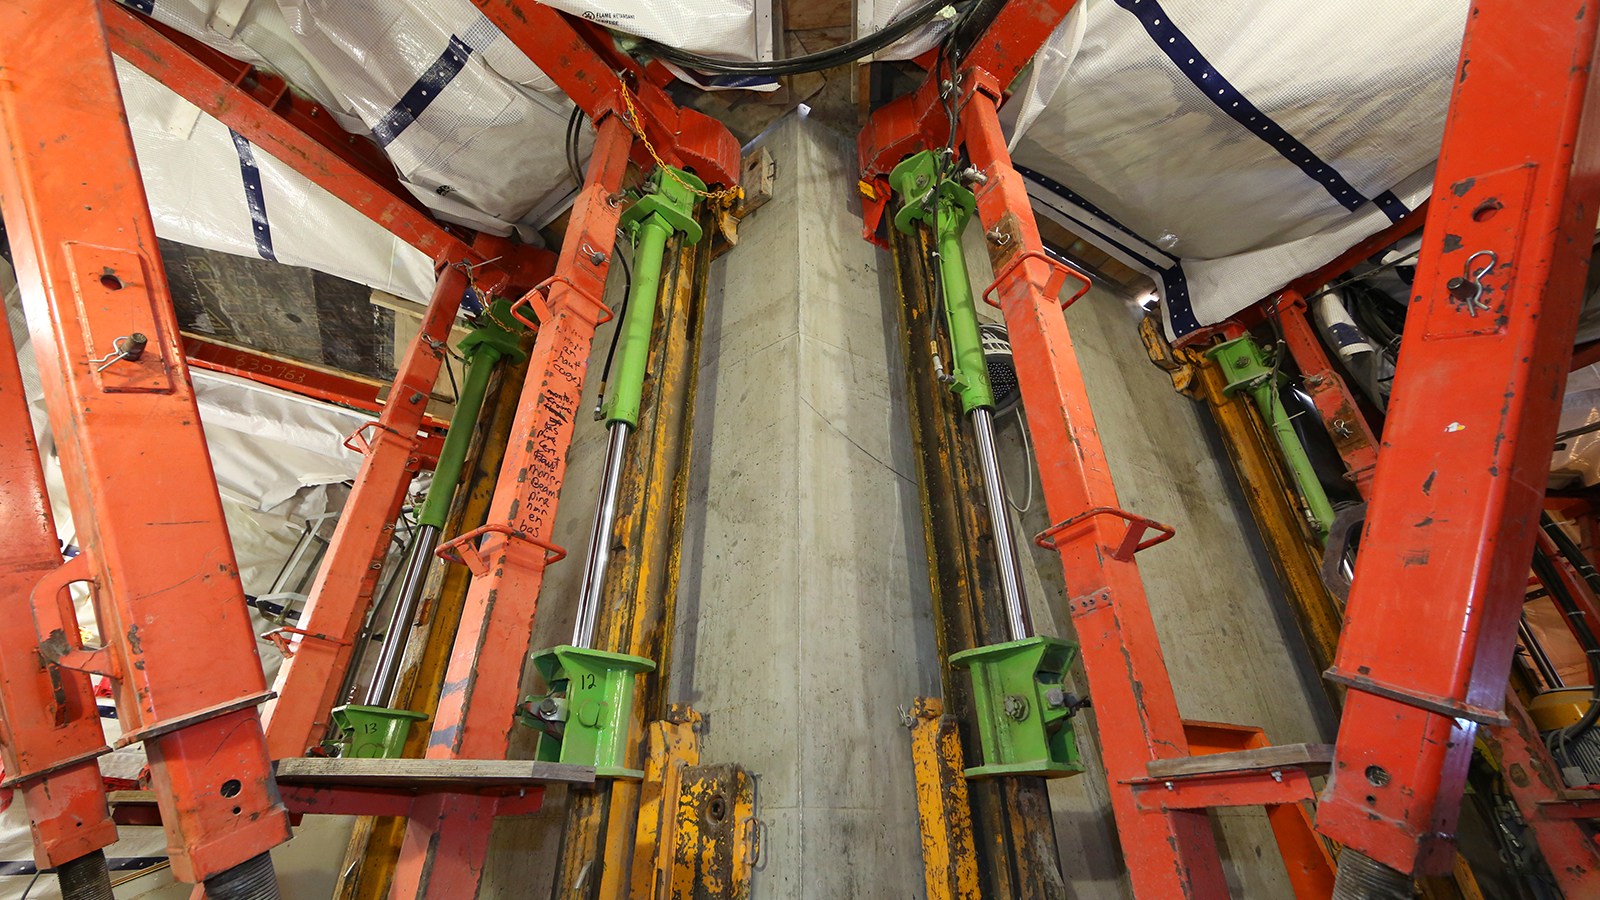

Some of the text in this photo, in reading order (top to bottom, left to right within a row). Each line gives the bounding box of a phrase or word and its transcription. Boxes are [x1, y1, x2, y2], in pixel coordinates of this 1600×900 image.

[235, 355, 306, 383] 830763
[520, 520, 539, 538] bas
[581, 674, 597, 690] 12
[364, 722, 378, 735] 13
